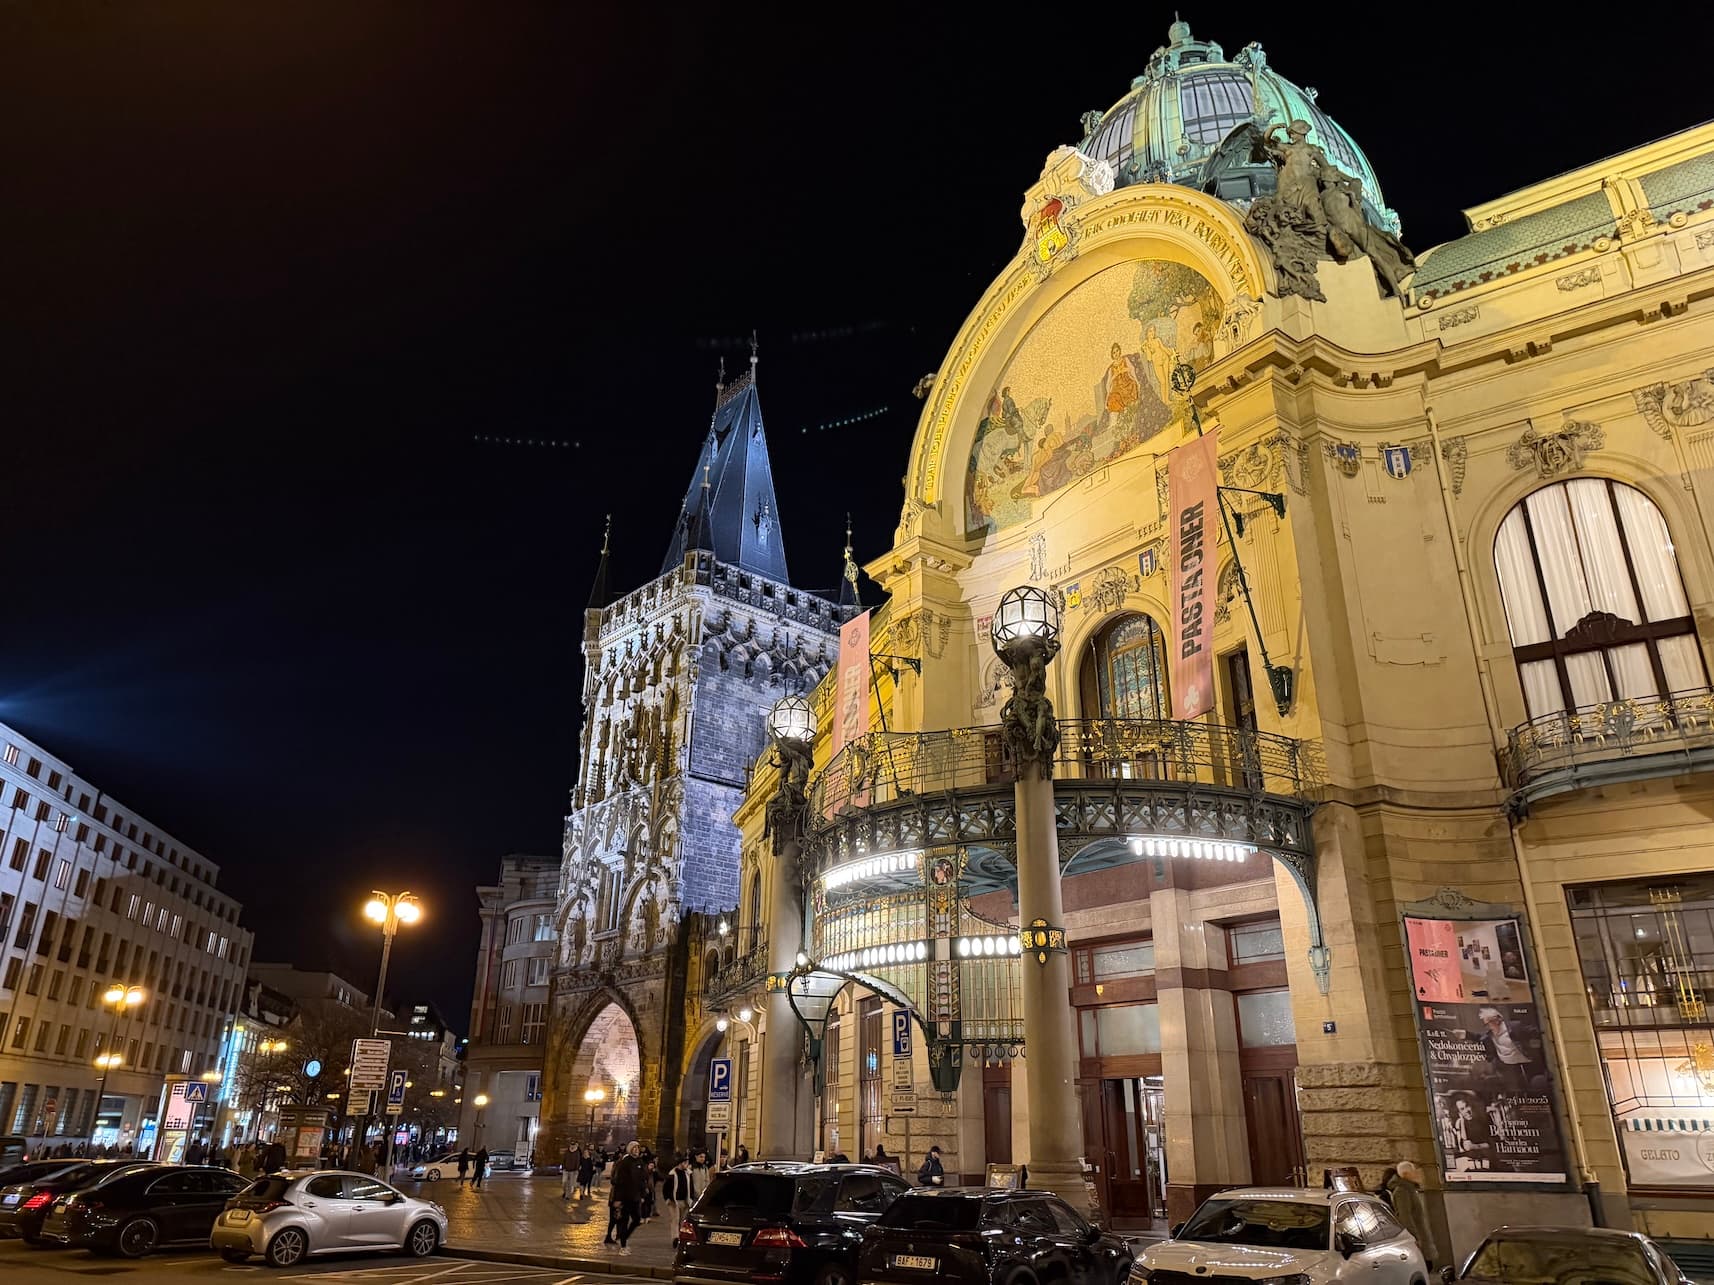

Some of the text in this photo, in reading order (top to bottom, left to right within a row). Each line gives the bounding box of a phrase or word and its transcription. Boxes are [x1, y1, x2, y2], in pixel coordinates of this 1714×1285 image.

[896, 1014, 907, 1042] P
[1430, 1050, 1437, 1060] &
[392, 1074, 403, 1095] P
[713, 1064, 727, 1089] P
